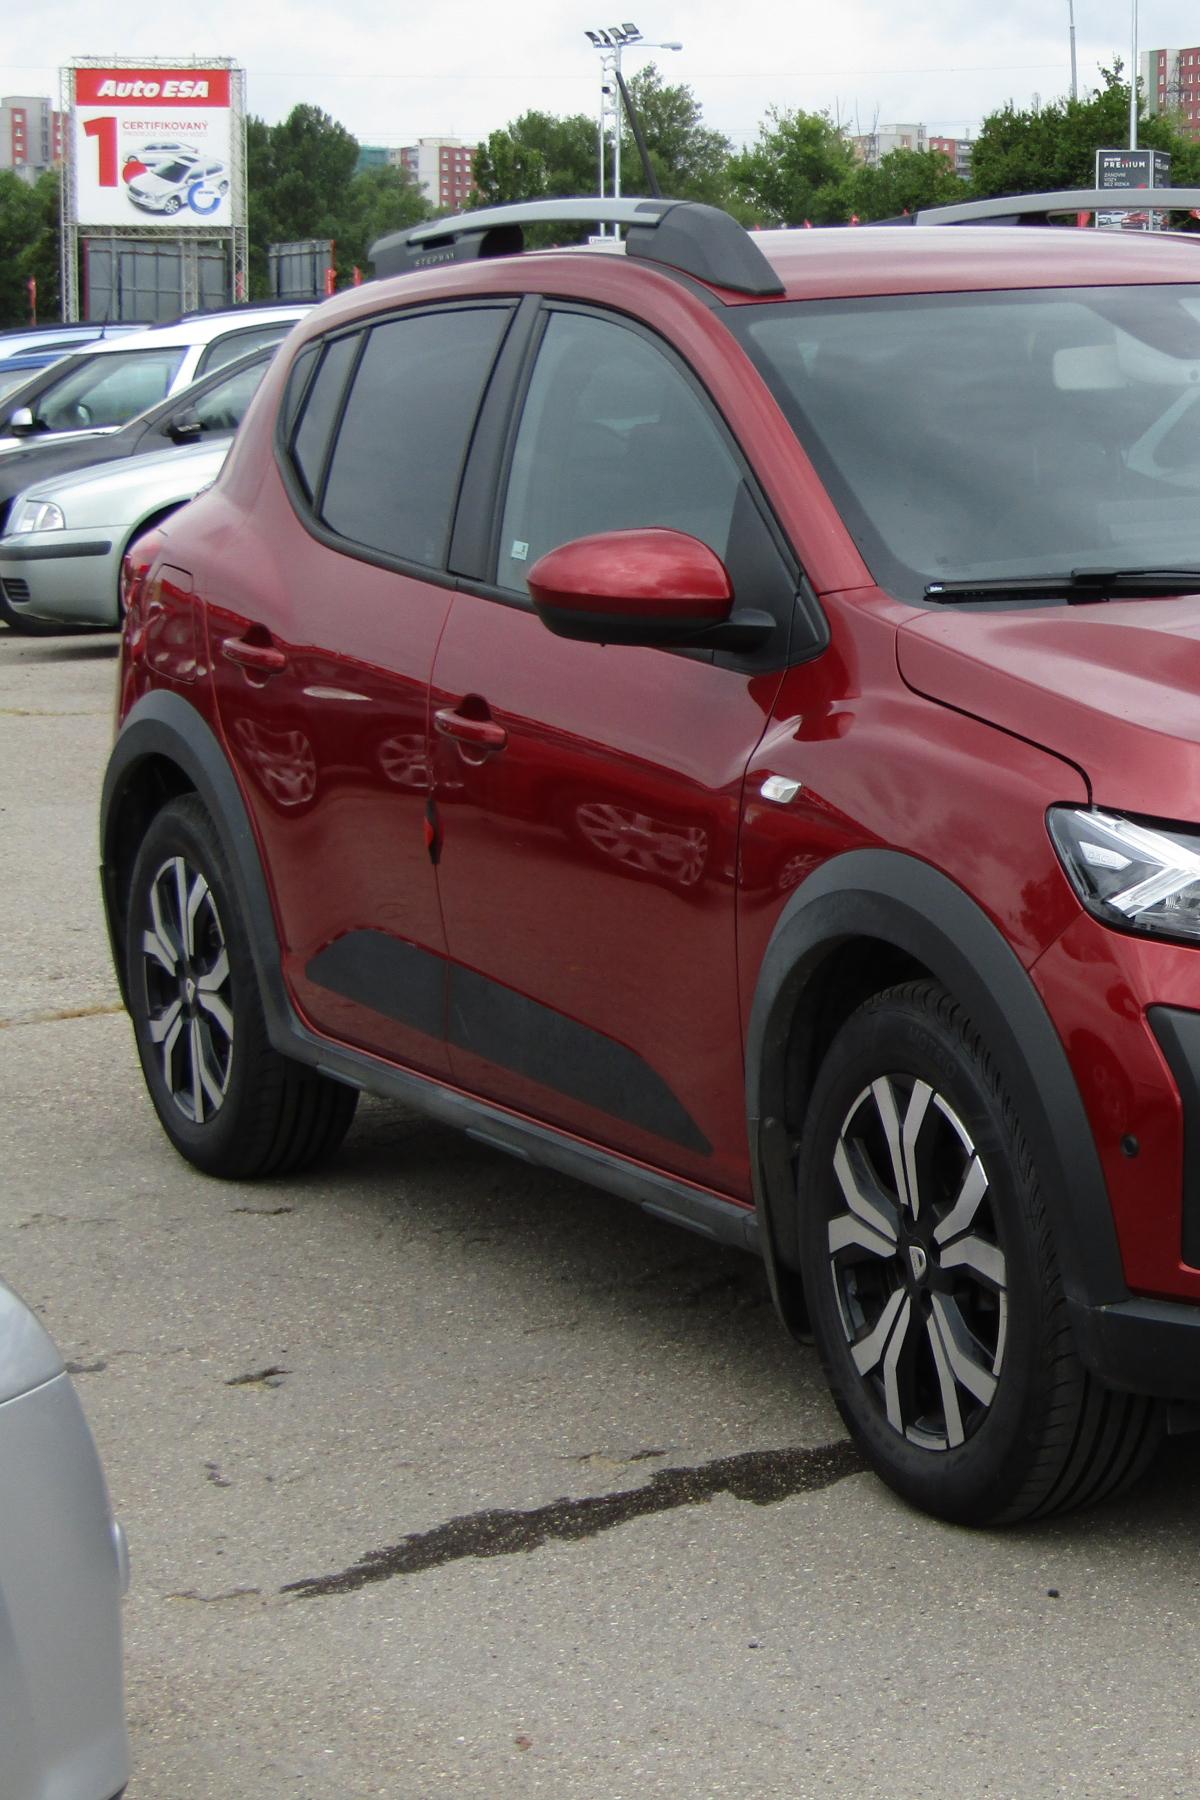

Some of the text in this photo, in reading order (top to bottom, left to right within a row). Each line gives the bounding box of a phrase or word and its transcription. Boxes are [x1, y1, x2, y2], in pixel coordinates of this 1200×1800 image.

[97, 80, 209, 98] Auto ESA
[83, 117, 118, 187] 1
[1104, 160, 1145, 168] PREMIUM
